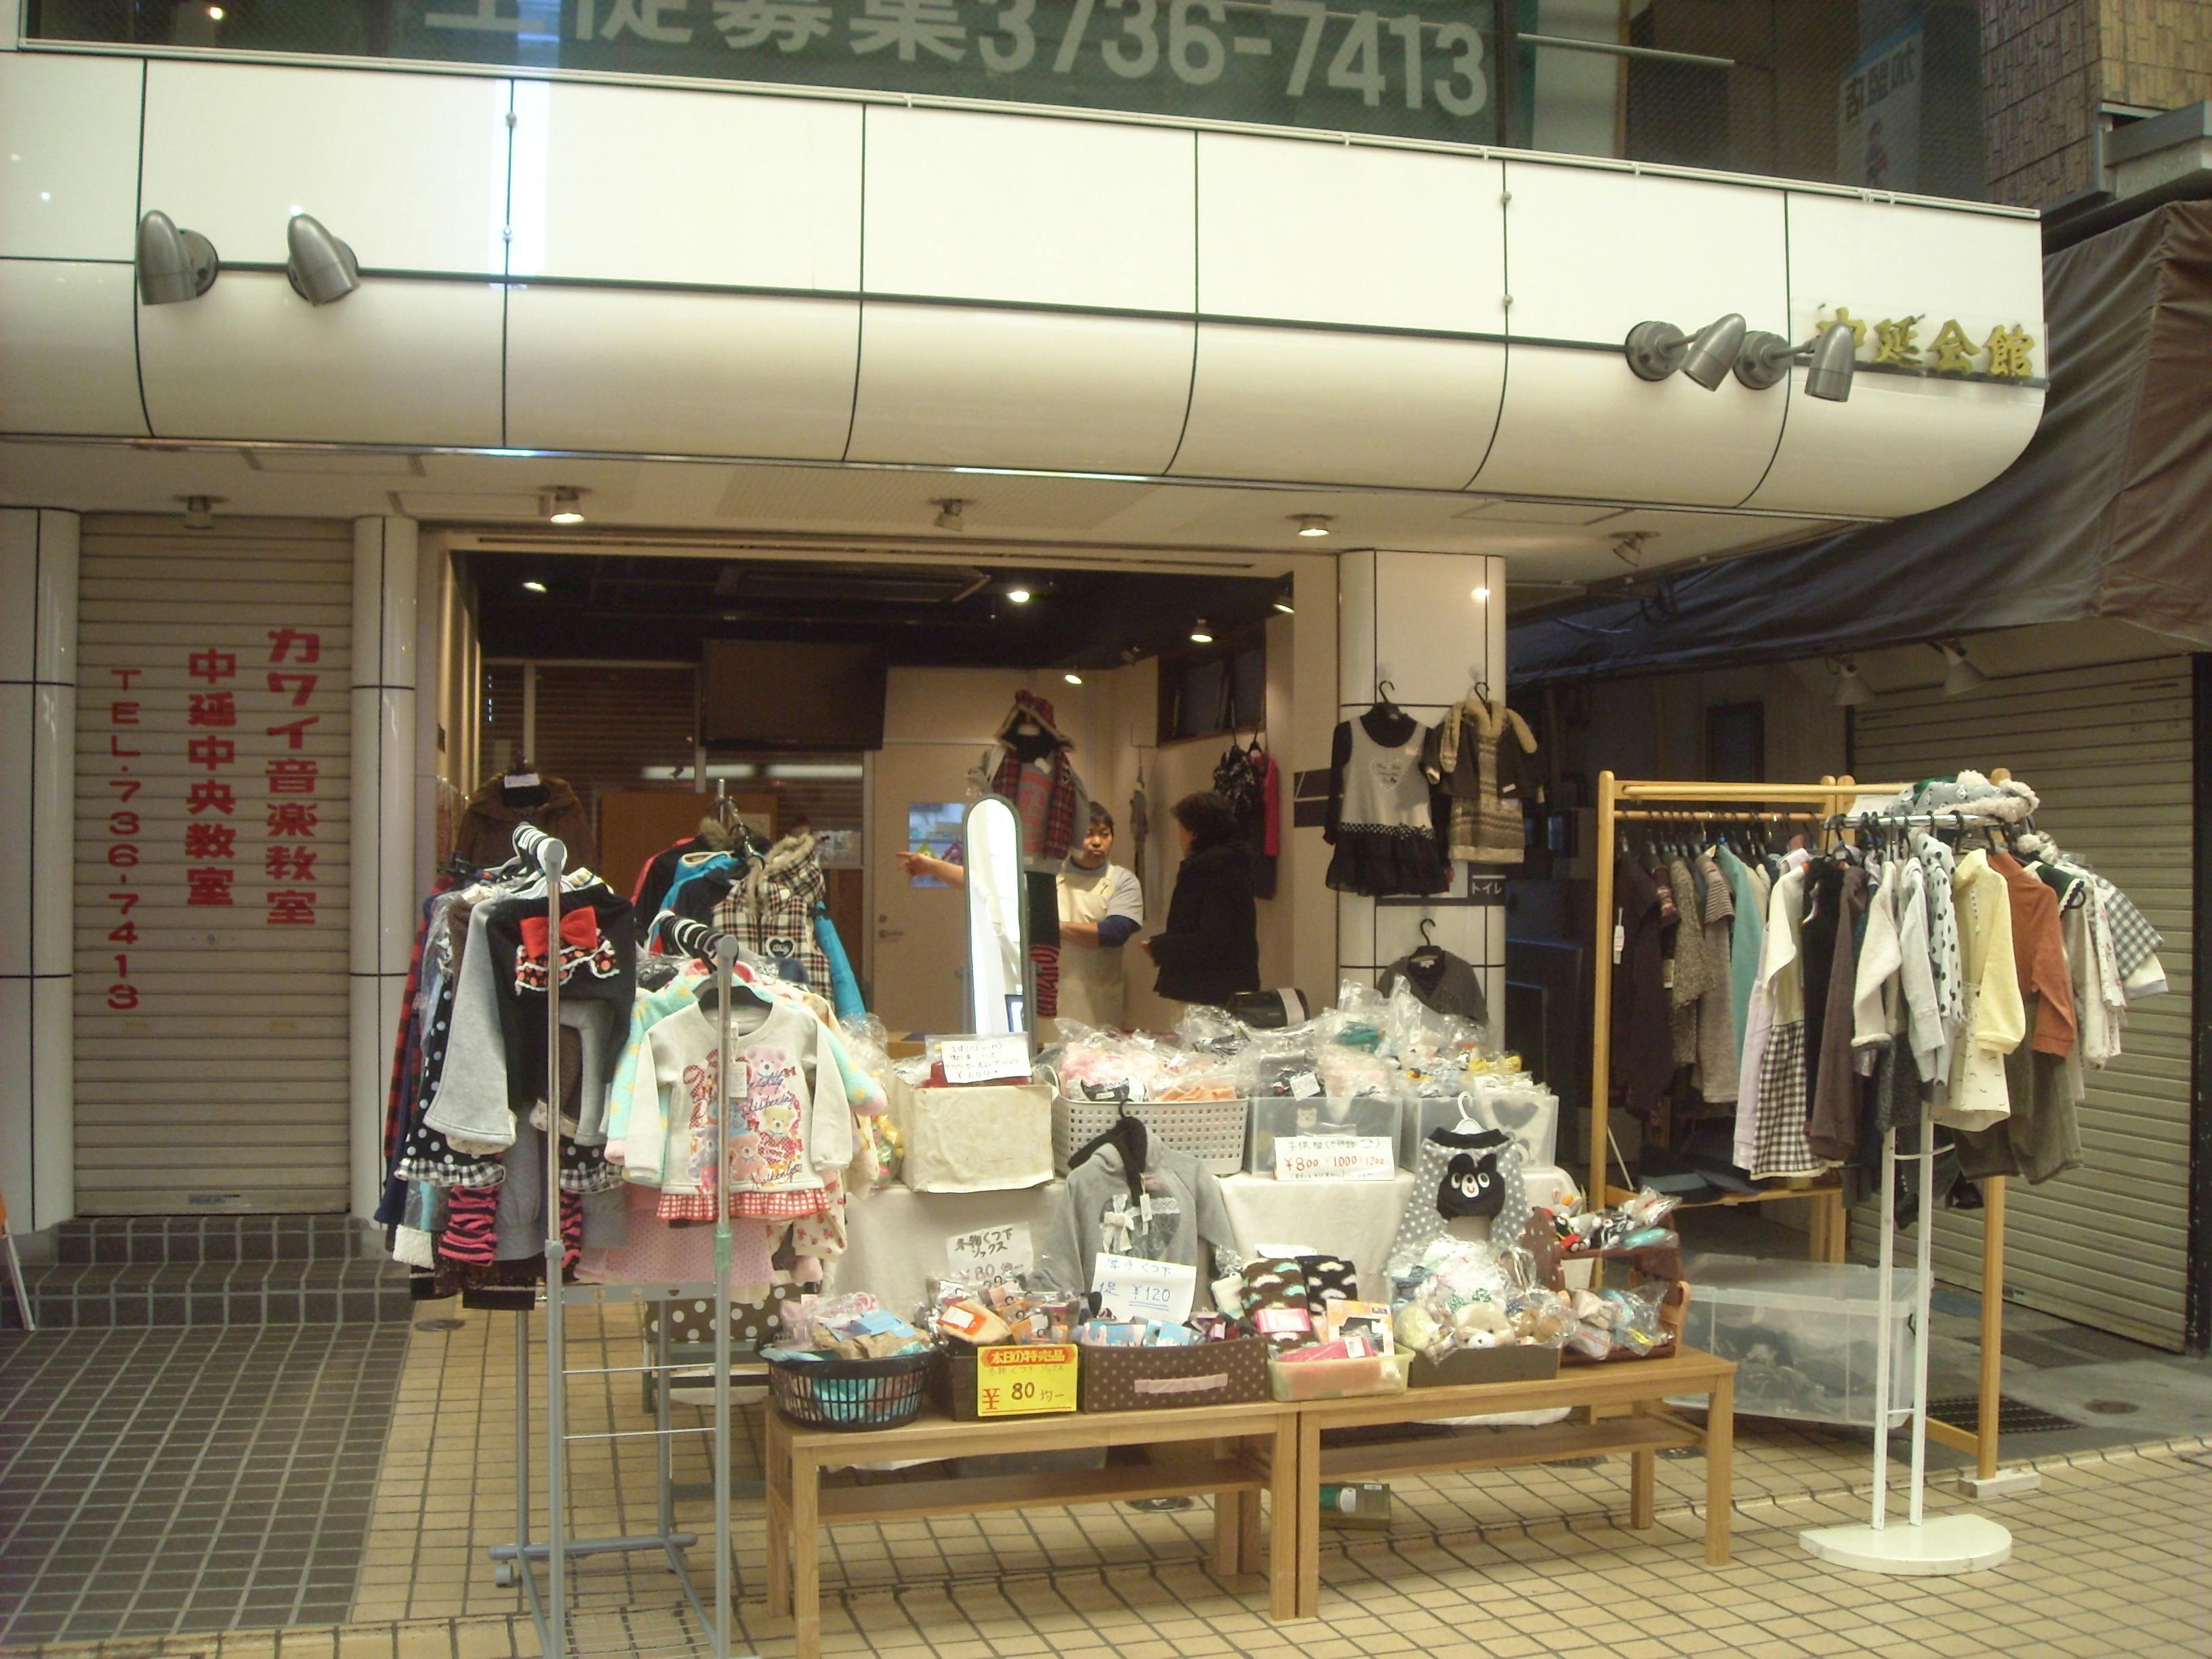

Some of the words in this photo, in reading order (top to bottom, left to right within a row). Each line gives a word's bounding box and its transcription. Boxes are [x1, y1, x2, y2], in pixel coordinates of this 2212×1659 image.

[185, 649, 236, 905] 中延中央教室
[266, 629, 320, 925] カワイ音楽教室
[1472, 882, 1502, 895] トイレ
[1284, 1157, 1319, 1171] ¥800
[1132, 1284, 1170, 1302] ¥120
[991, 1349, 1065, 1365] 本日の特売品
[1011, 1382, 1035, 1400] 80
[1040, 1390, 1064, 1402] 均一
